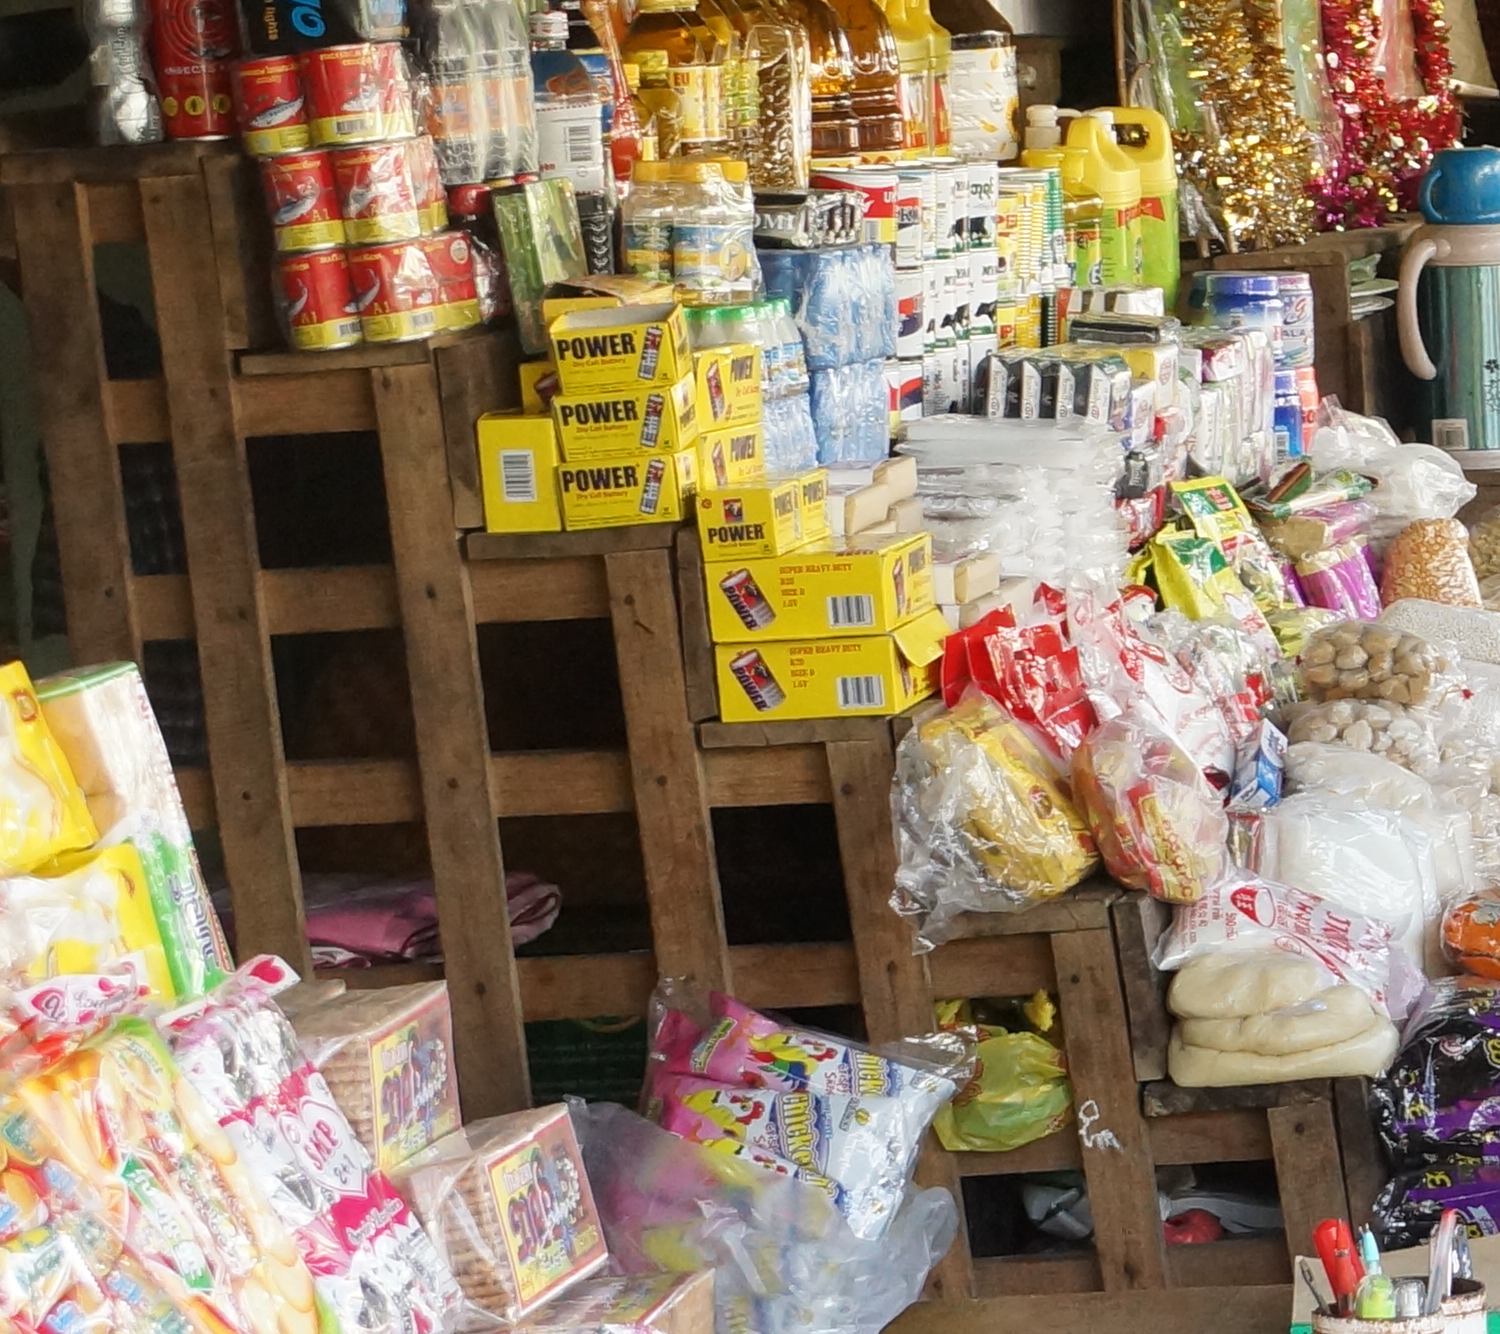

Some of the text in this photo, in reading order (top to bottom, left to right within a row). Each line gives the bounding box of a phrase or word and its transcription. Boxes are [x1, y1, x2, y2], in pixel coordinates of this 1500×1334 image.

[557, 332, 636, 362] POWER
[560, 398, 639, 427] POWER
[562, 465, 639, 493] POWER
[708, 525, 766, 544] POWER
[724, 585, 759, 630] POWER
[735, 666, 769, 711] POWER
